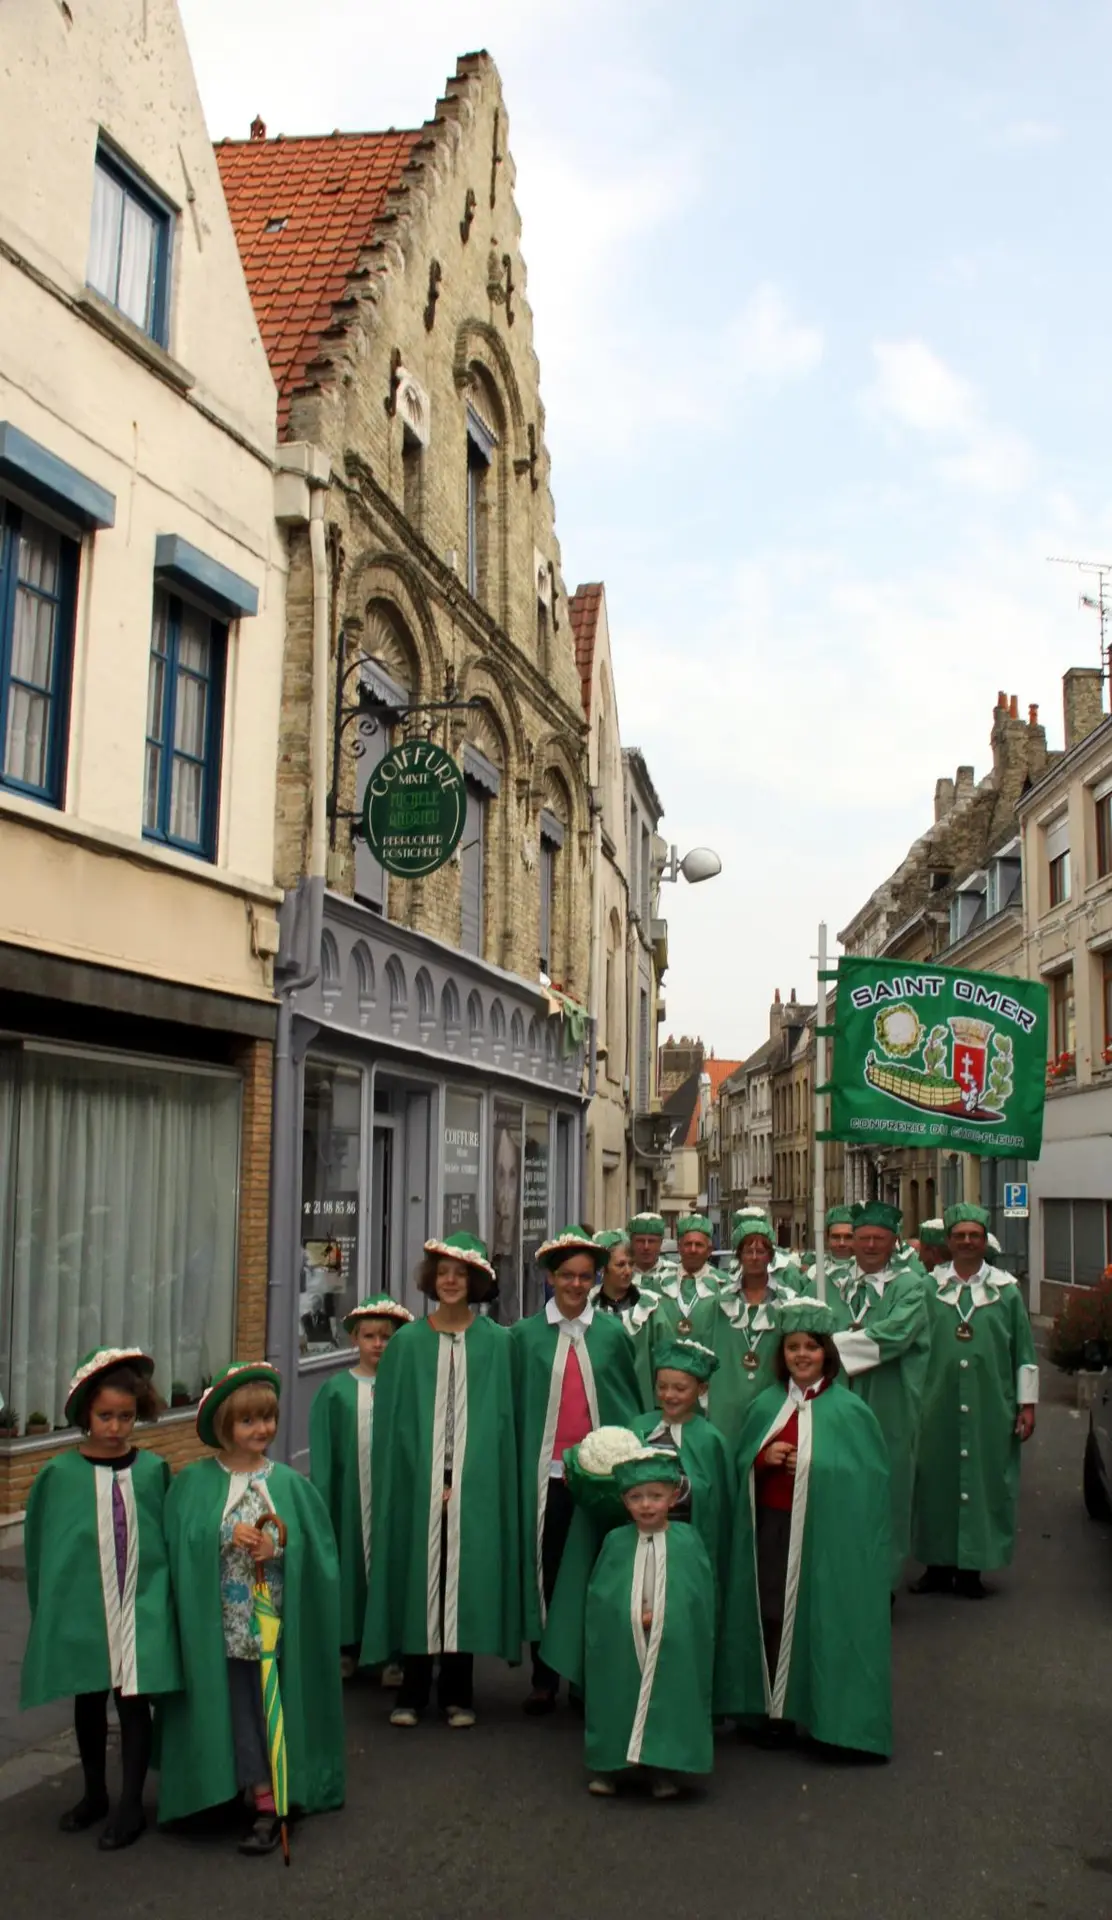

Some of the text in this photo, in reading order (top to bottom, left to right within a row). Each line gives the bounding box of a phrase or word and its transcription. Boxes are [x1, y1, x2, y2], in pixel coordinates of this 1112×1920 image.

[371, 747, 460, 796] COIFFURE
[399, 773, 429, 785] MIXTE
[382, 834, 443, 847] PERRUQUIER
[382, 847, 443, 859] POSTICHEUR
[851, 976, 1037, 1033] SAINT OMER
[930, 1124, 949, 1136] DU
[444, 1128, 479, 1147] COIFFURE
[313, 1200, 321, 1214] 21
